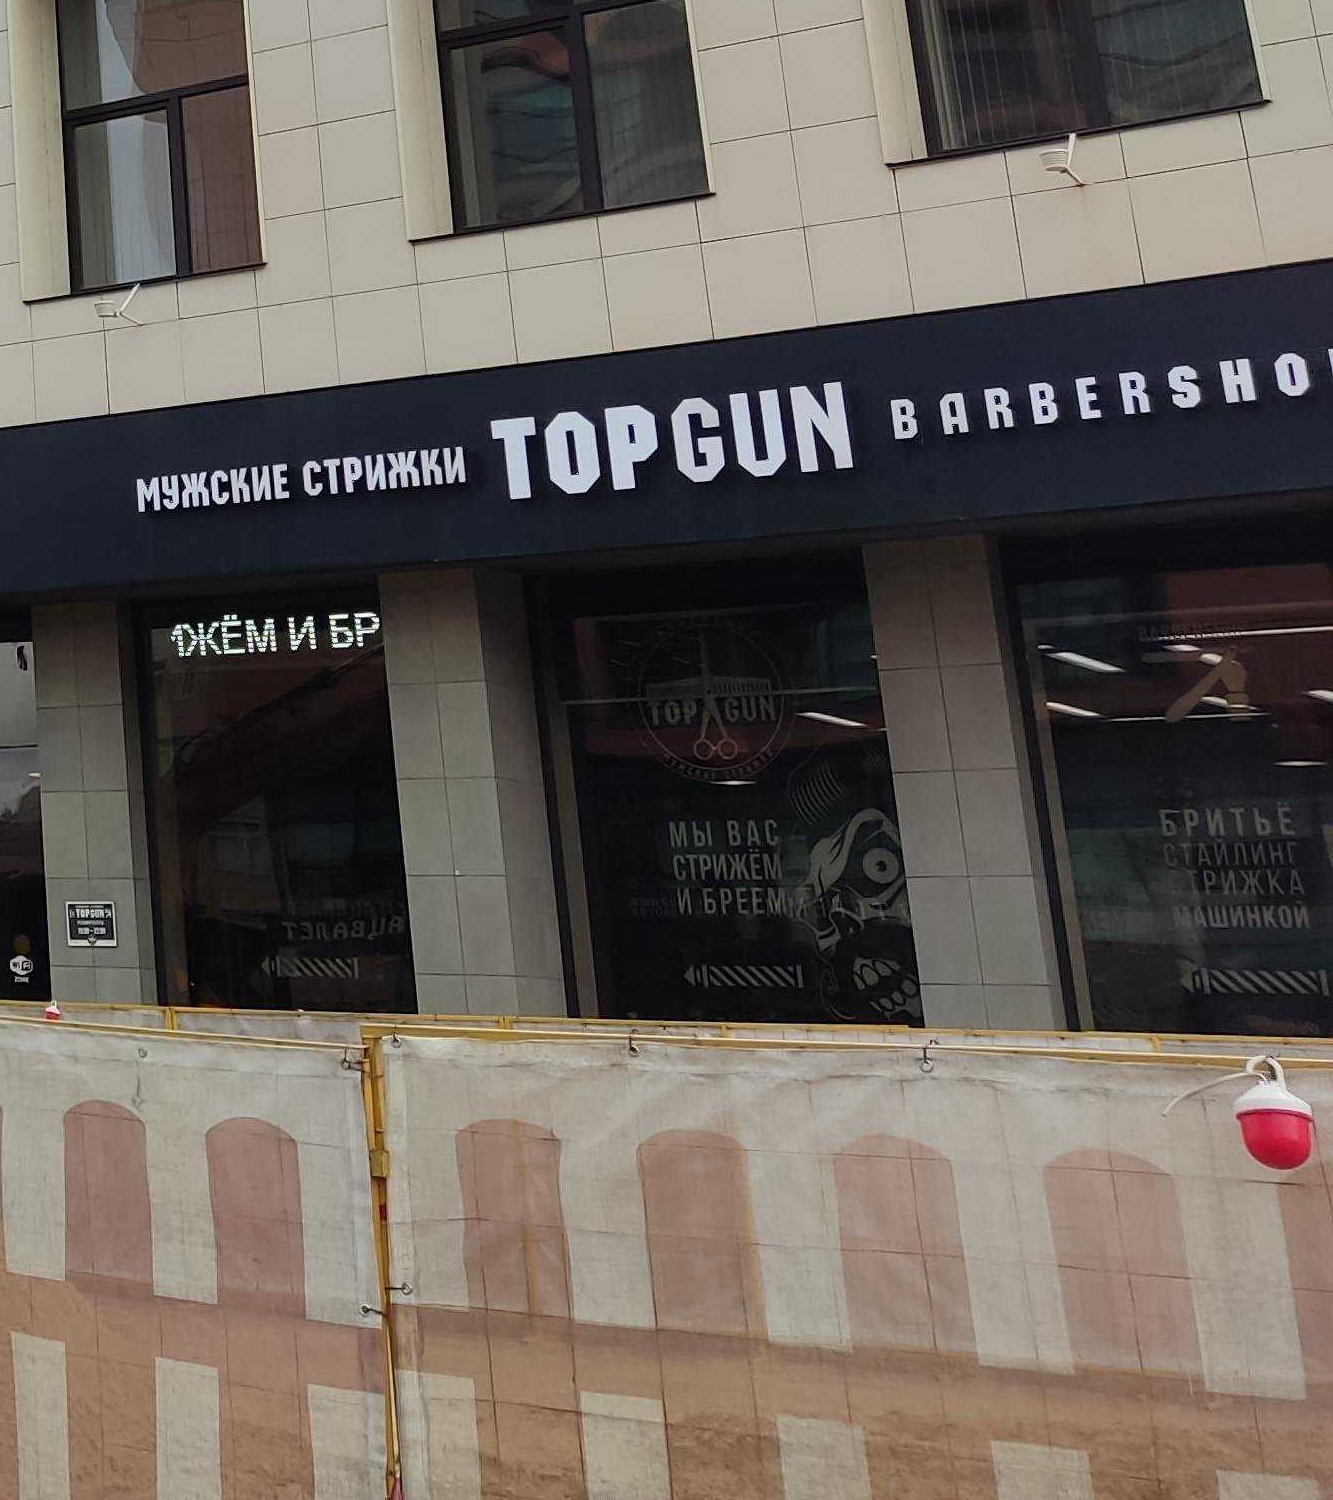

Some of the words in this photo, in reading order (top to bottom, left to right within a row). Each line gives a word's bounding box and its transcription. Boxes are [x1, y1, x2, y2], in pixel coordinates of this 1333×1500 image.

[137, 462, 290, 513] МУЖСКИЕ
[302, 445, 467, 498] СТРИЖКИ
[287, 615, 317, 651] И
[648, 699, 697, 727] TOP
[724, 695, 777, 724] GUN
[668, 820, 713, 848] МЫ
[727, 818, 779, 847] ВАС
[1158, 802, 1296, 837] БРИТЬЁ
[671, 848, 783, 882] СТРИЖЁМ
[1164, 838, 1299, 868] СТАЙЛИНГ
[676, 887, 693, 917] И
[702, 886, 785, 917] БРЕЕМ
[1173, 900, 1311, 930] МАШИНКОЙ
